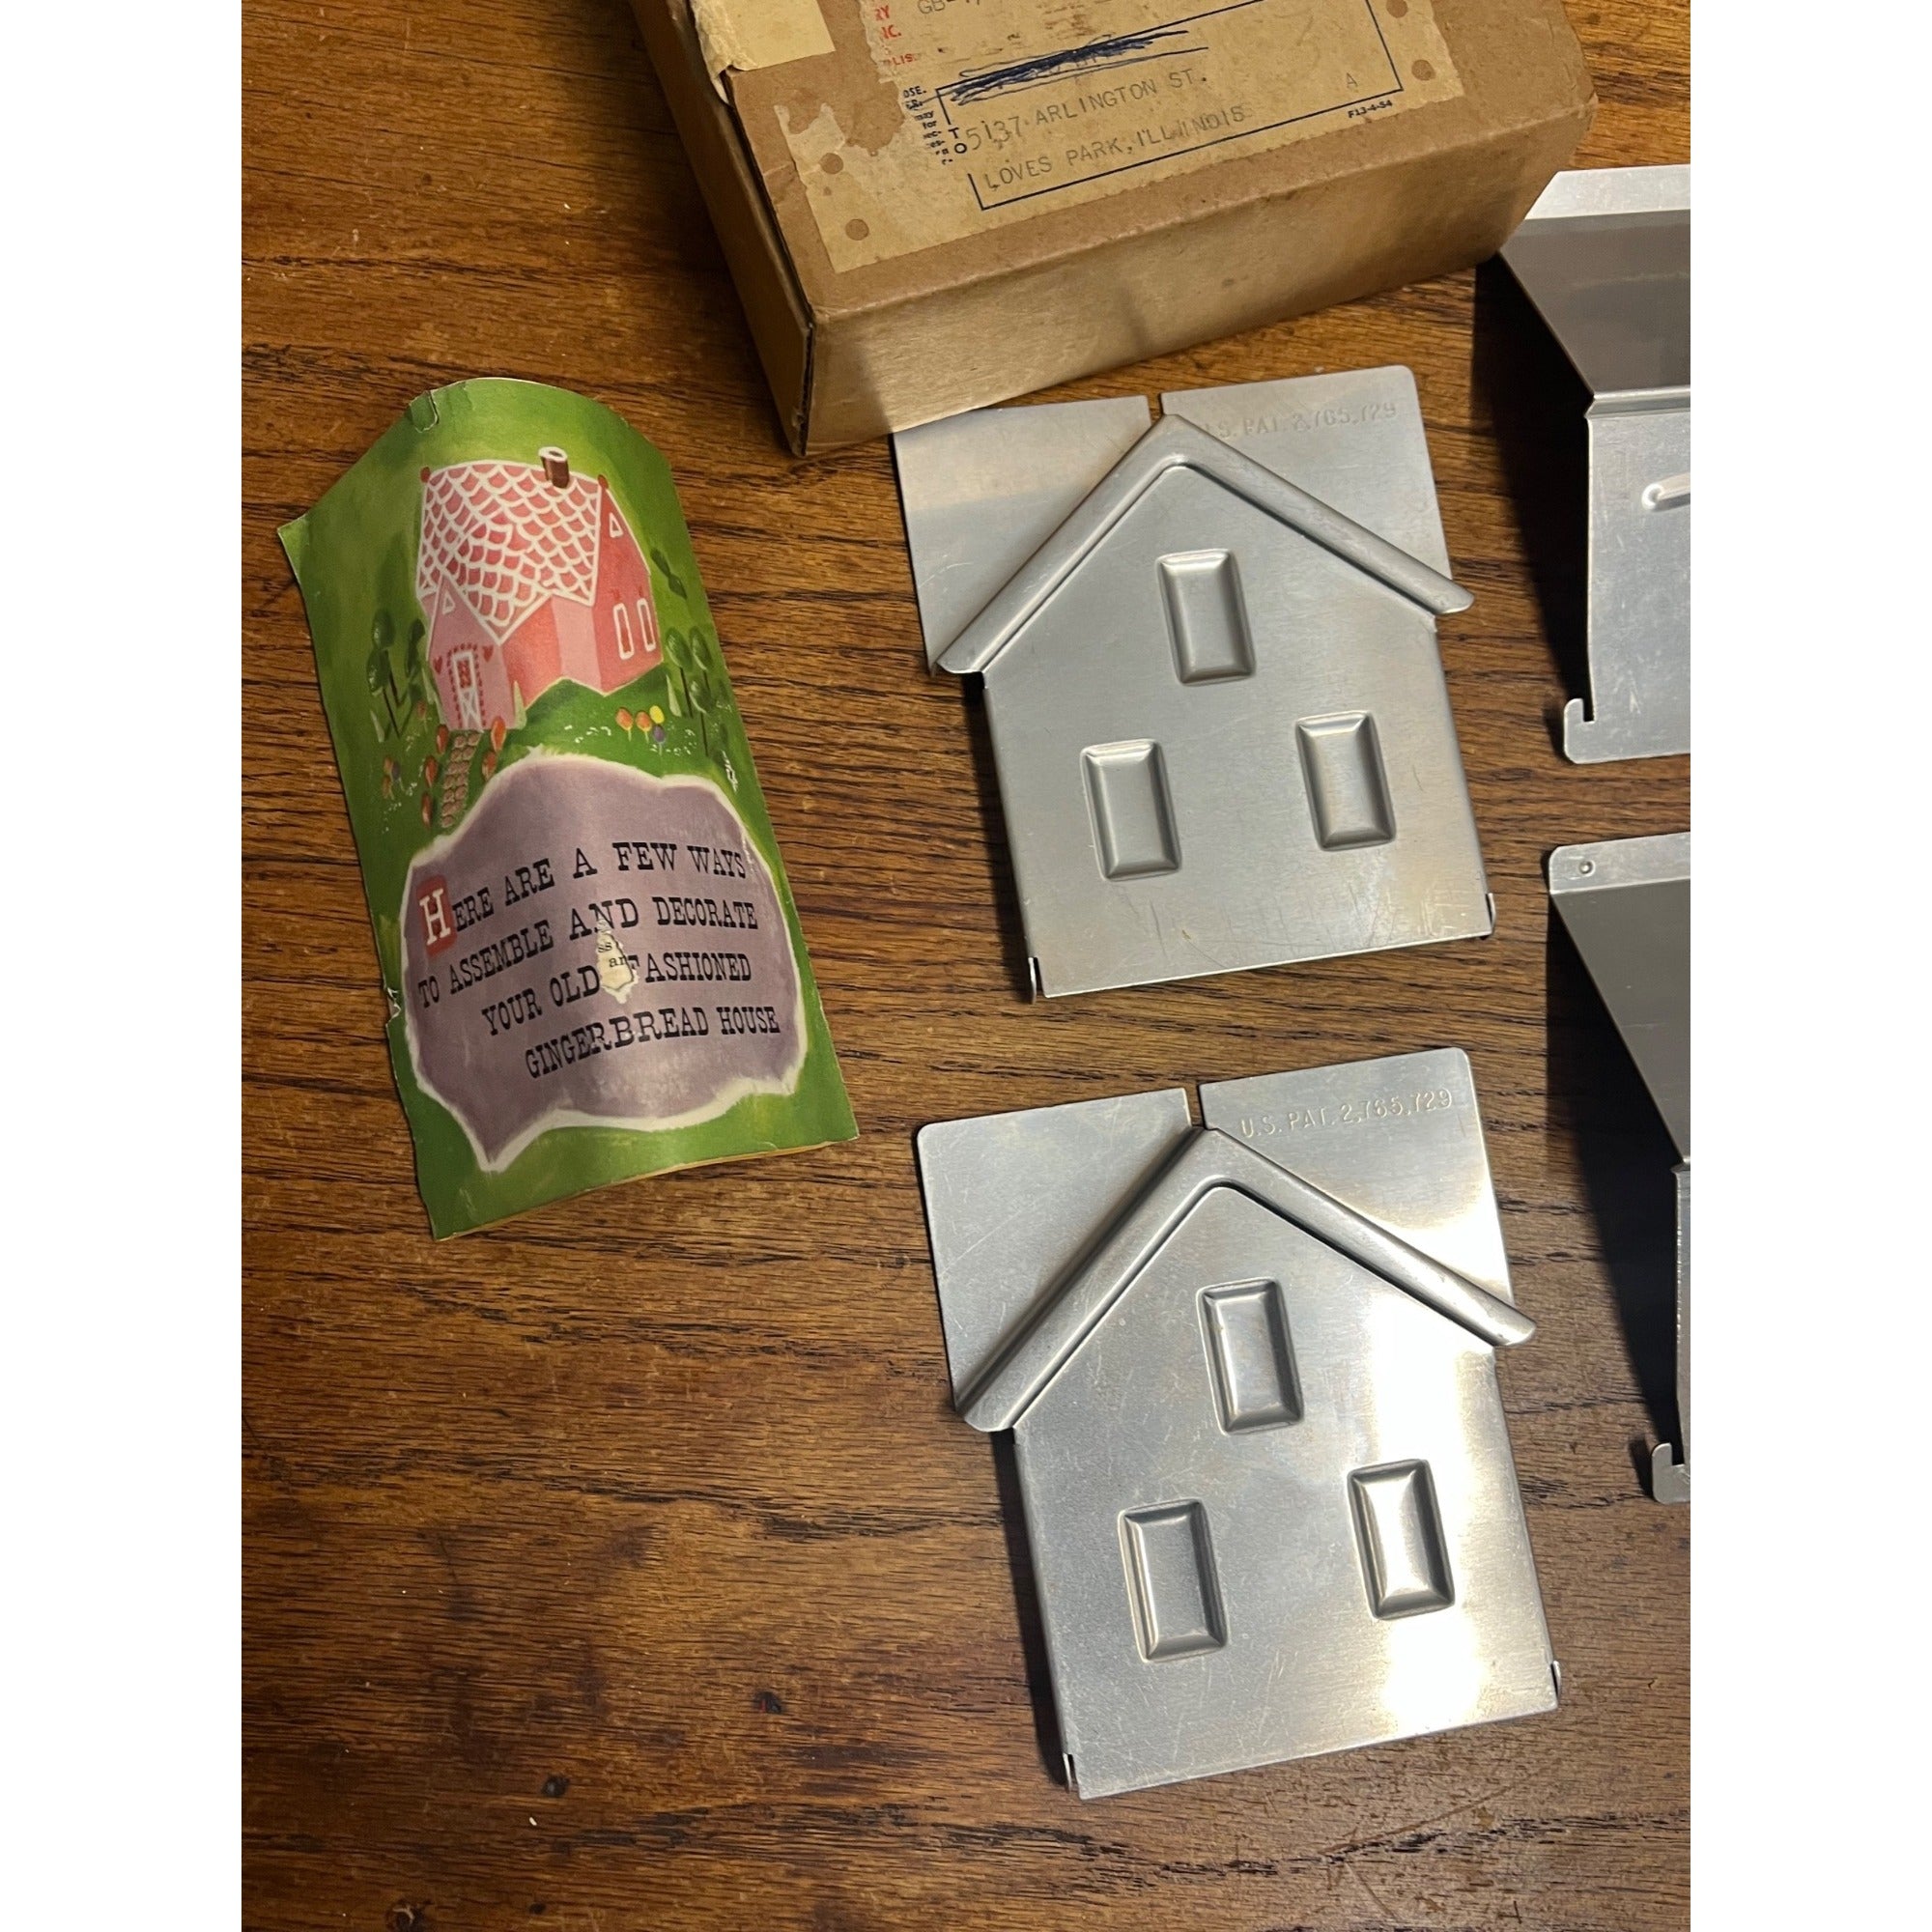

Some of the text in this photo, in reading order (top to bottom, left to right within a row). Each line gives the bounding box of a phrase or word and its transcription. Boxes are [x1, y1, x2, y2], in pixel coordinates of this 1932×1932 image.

[967, 68, 1207, 150] 5137 ARLINGTON ST.
[984, 155, 1053, 189] LOVES
[418, 841, 747, 947] HERE ARE A FEW WAYS
[418, 896, 758, 1009] TO ASSEMBLE AND DECORATE
[482, 988, 543, 1037] YOUR
[549, 964, 601, 1008] OLD
[525, 1006, 781, 1079] GINGERBREAD HOUSE
[1240, 1114, 1282, 1139] U.S.
[1289, 1107, 1336, 1129] PAT.
